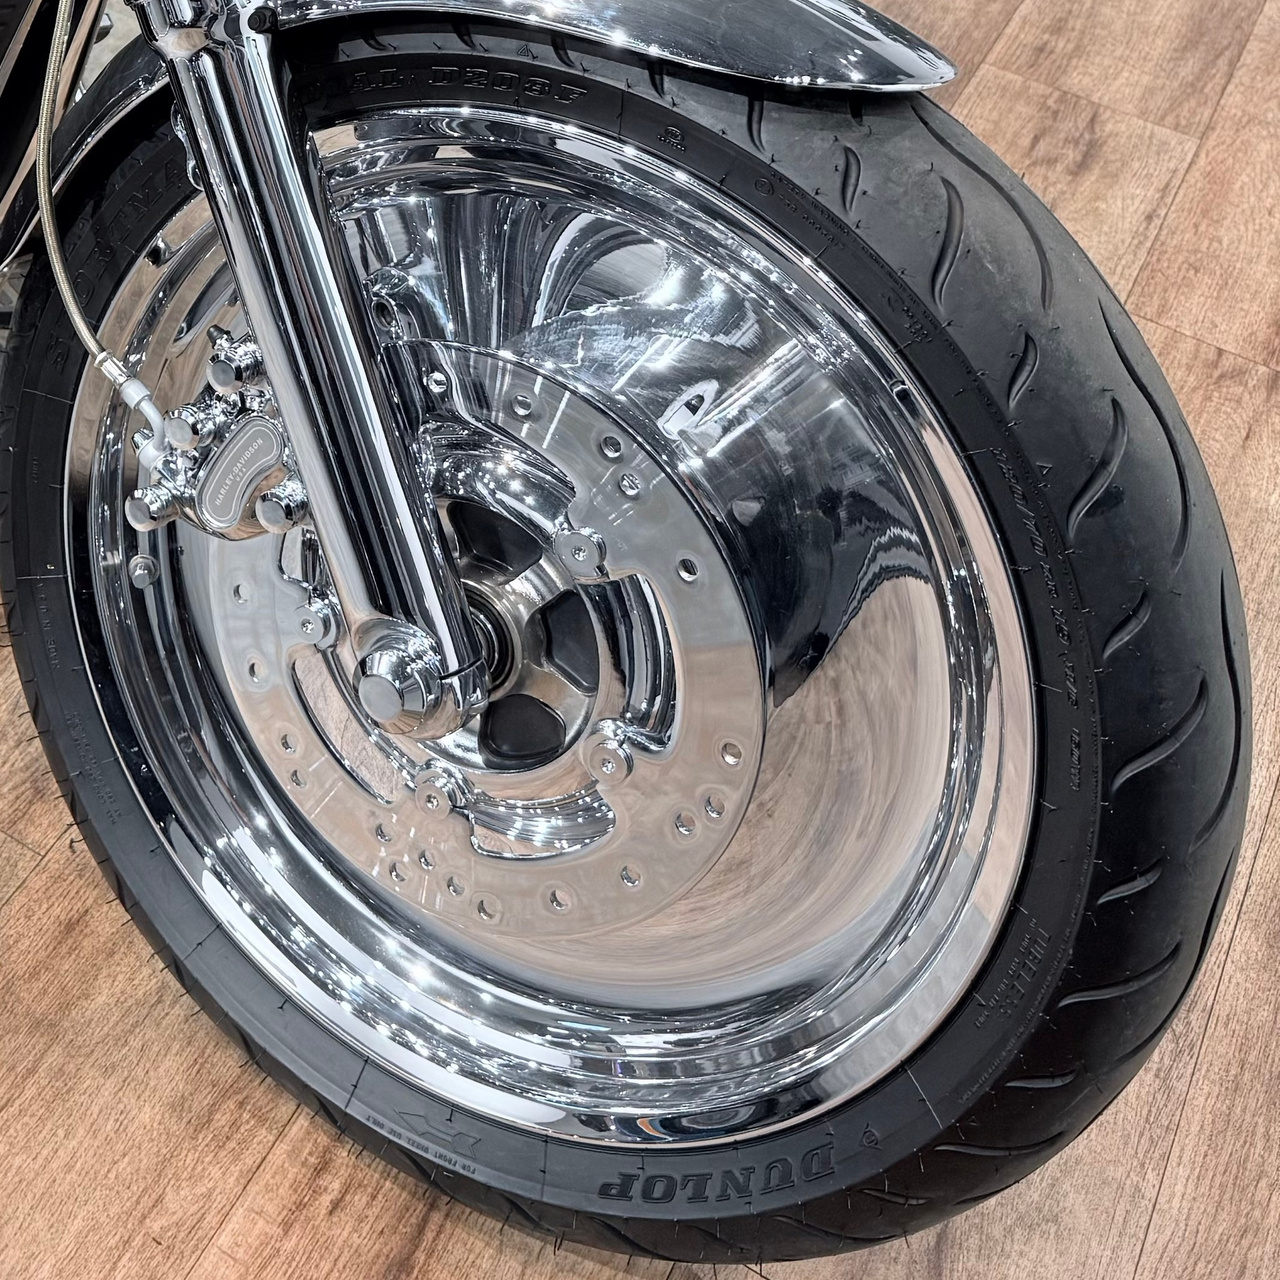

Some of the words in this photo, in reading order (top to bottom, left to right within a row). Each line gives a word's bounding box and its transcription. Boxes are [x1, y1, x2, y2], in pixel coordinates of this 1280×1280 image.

[428, 66, 588, 104] D208F
[997, 927, 1052, 1019] TUBELESS
[598, 1140, 835, 1203] DUNLOP
